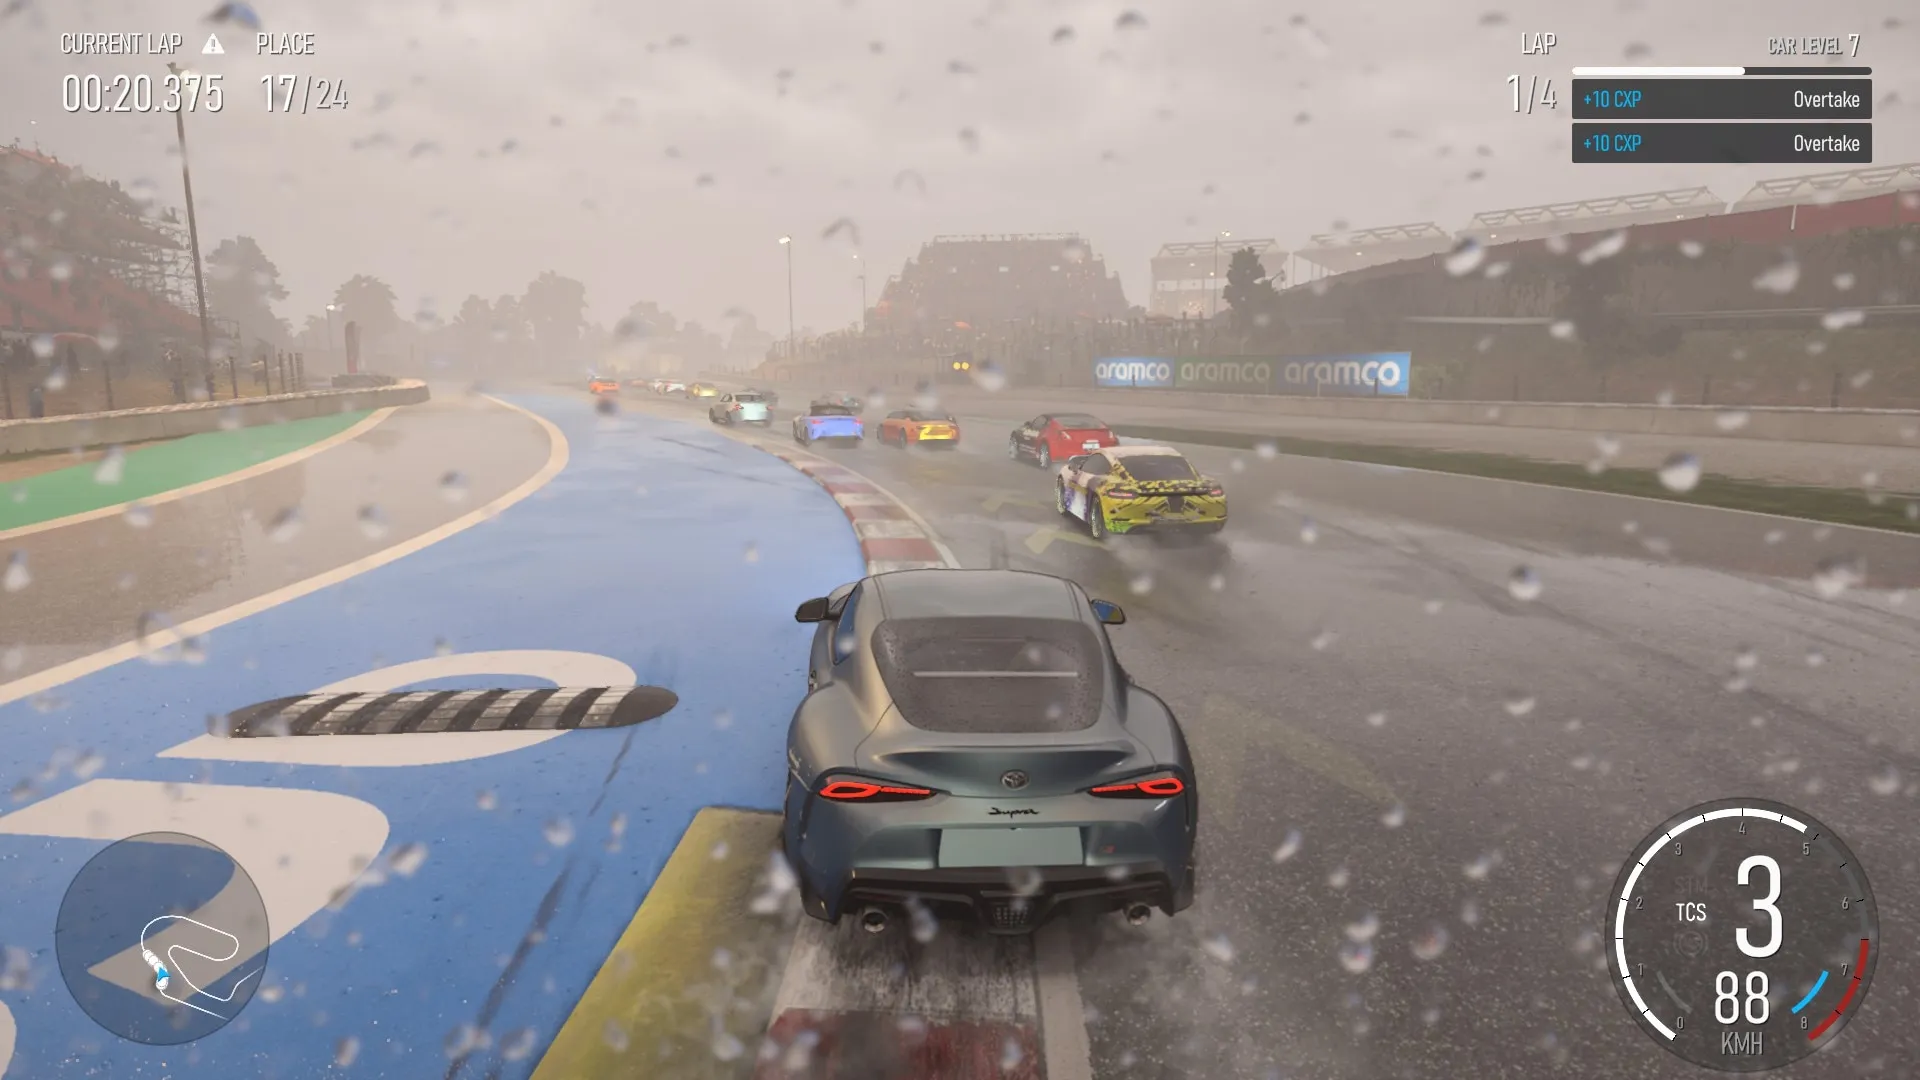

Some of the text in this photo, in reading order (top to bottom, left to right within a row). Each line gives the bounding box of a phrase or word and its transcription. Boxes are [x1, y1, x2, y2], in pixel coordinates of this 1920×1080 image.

[1095, 361, 1171, 381] aramco
[1180, 360, 1271, 384] aramco
[1284, 360, 1401, 388] aramco
